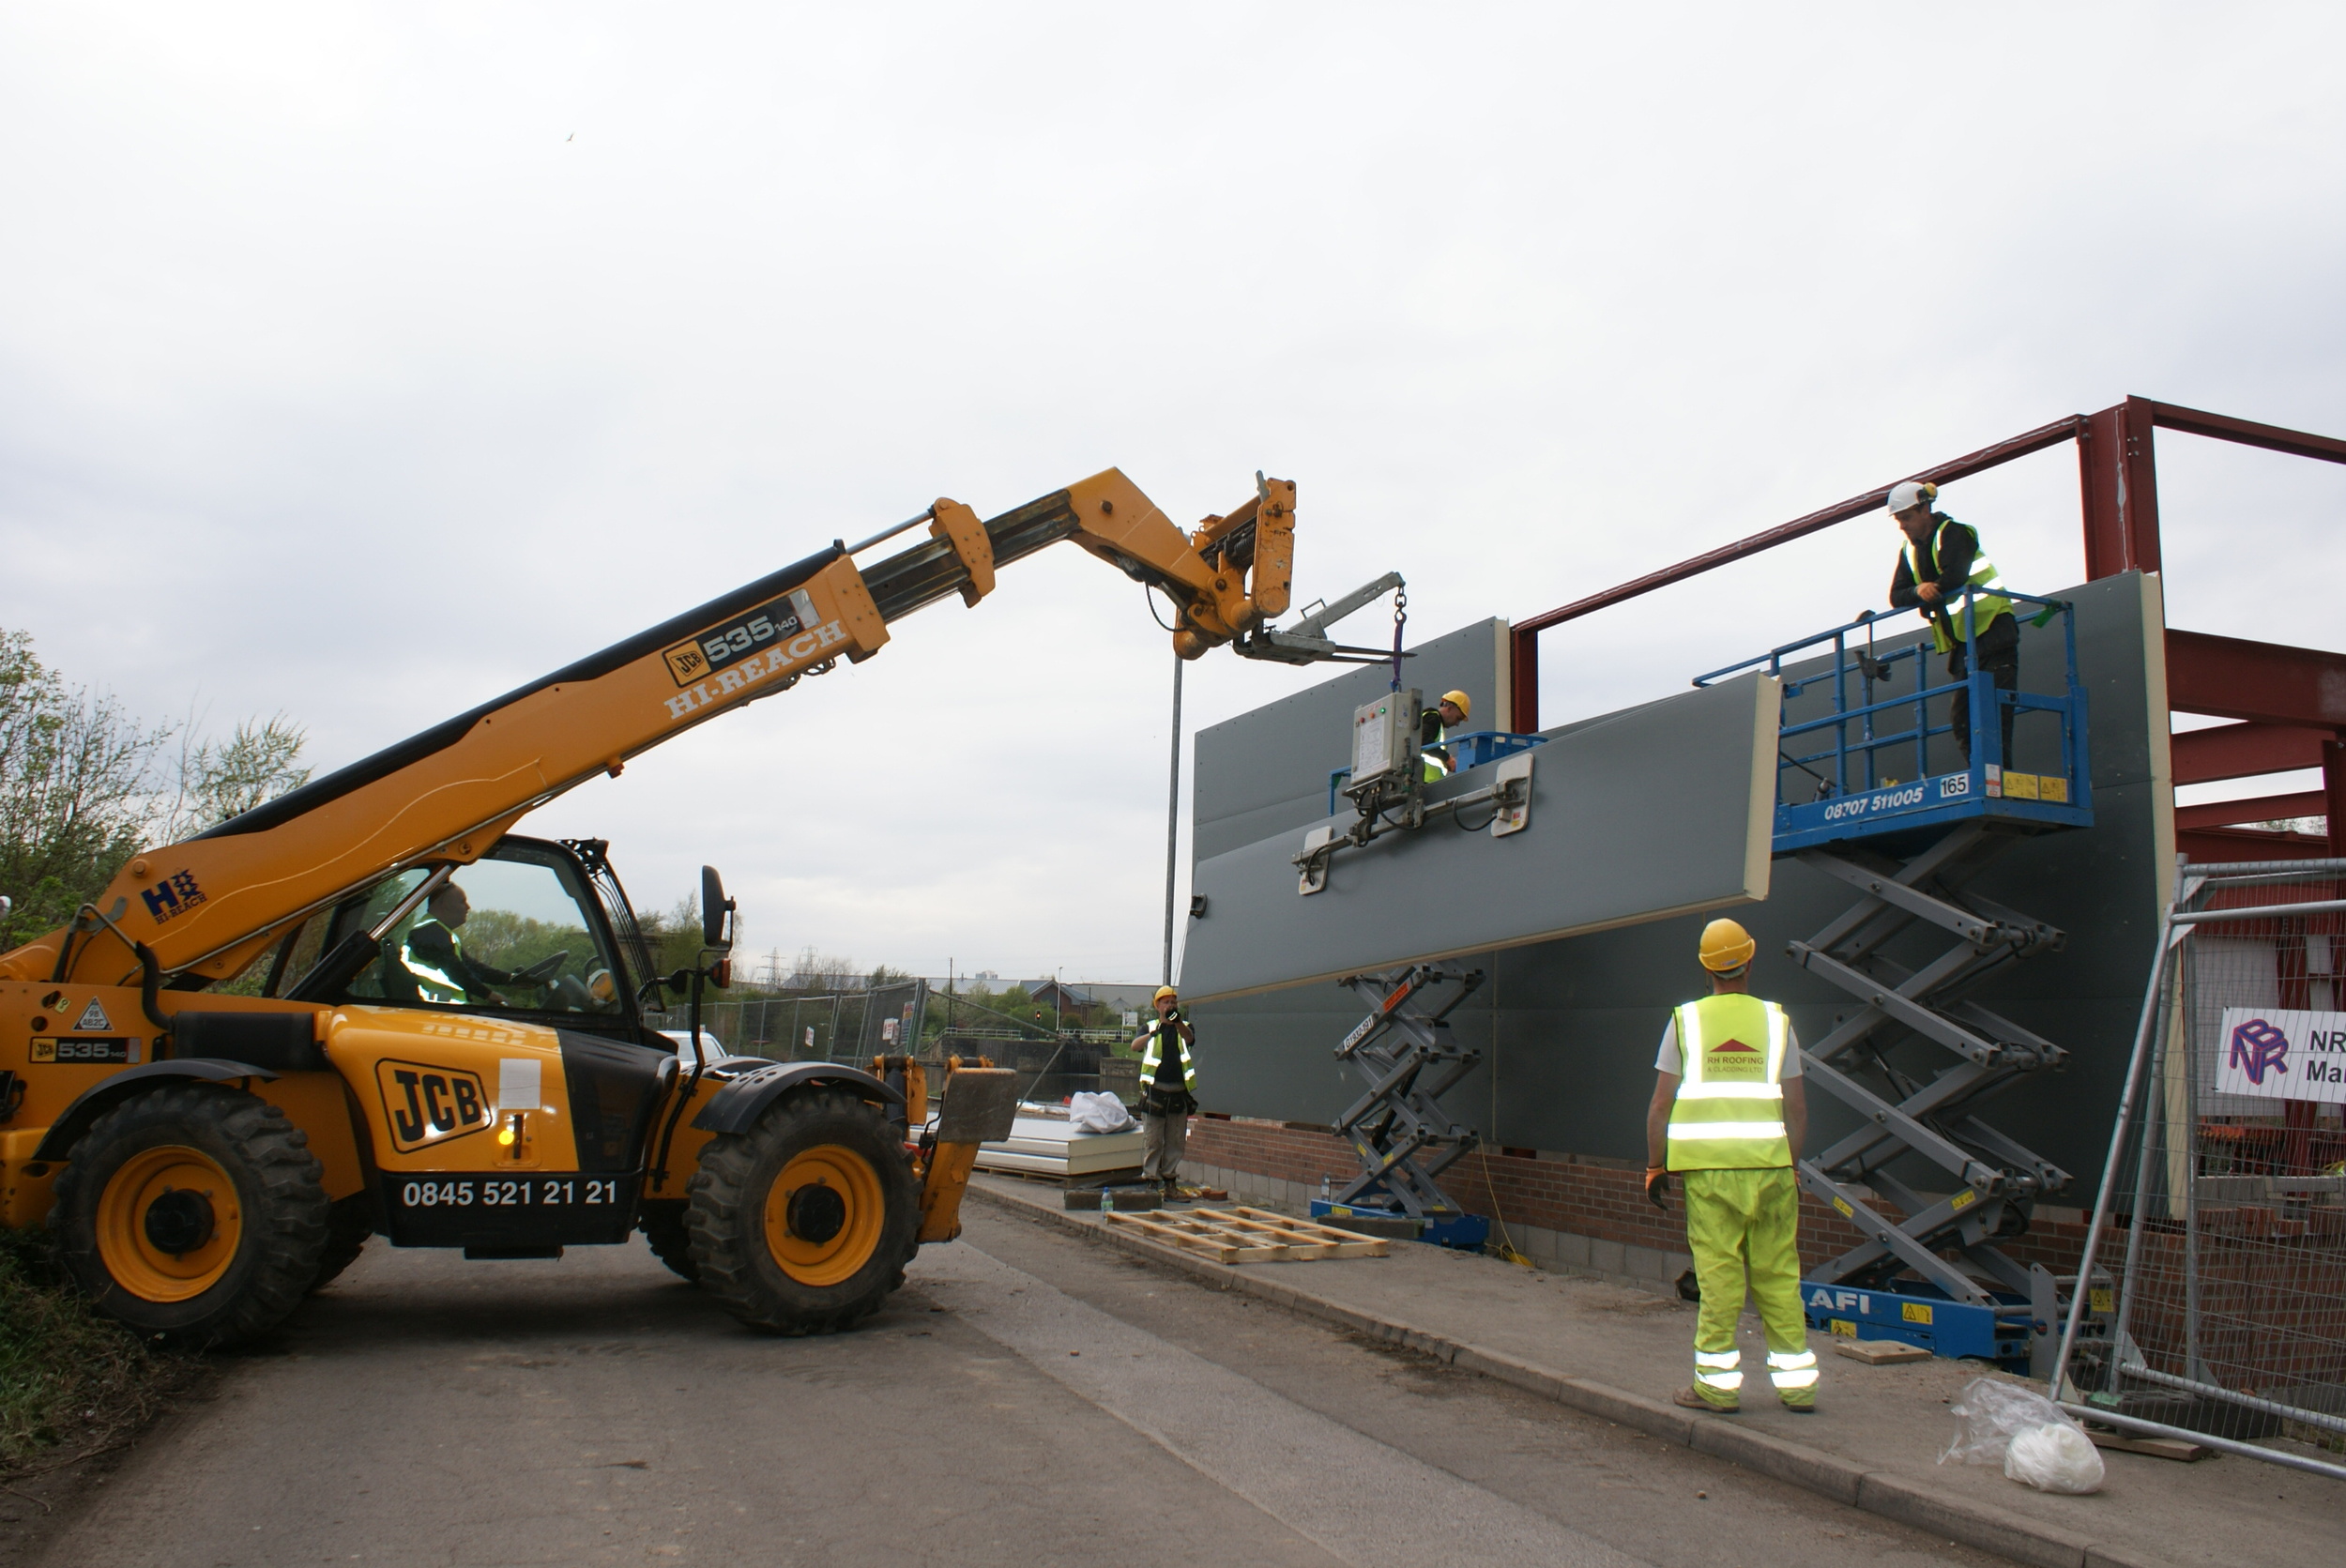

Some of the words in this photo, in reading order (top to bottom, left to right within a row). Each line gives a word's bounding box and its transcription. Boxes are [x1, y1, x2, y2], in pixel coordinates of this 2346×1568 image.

[676, 651, 702, 673] JCB
[703, 616, 775, 662] 535
[774, 616, 798, 632] 140
[663, 619, 846, 720] HI-REACH
[1941, 776, 1967, 796] 165
[1824, 798, 1867, 821] 08707
[1871, 786, 1924, 812] 511005
[155, 892, 207, 925] HI-REACH
[1345, 1016, 1373, 1048] G1932-191
[2309, 1030, 2346, 1053] NR
[38, 1043, 53, 1057] JCB
[58, 1043, 110, 1058] 535
[1722, 1057, 1764, 1065] ROOFING
[2307, 1060, 2346, 1083] Ma
[394, 1069, 481, 1143] JCB
[403, 1181, 474, 1207] 0845
[482, 1180, 531, 1206] 521
[542, 1180, 574, 1205] 21
[586, 1180, 616, 1204] 21
[1808, 1288, 1869, 1315] AFI
